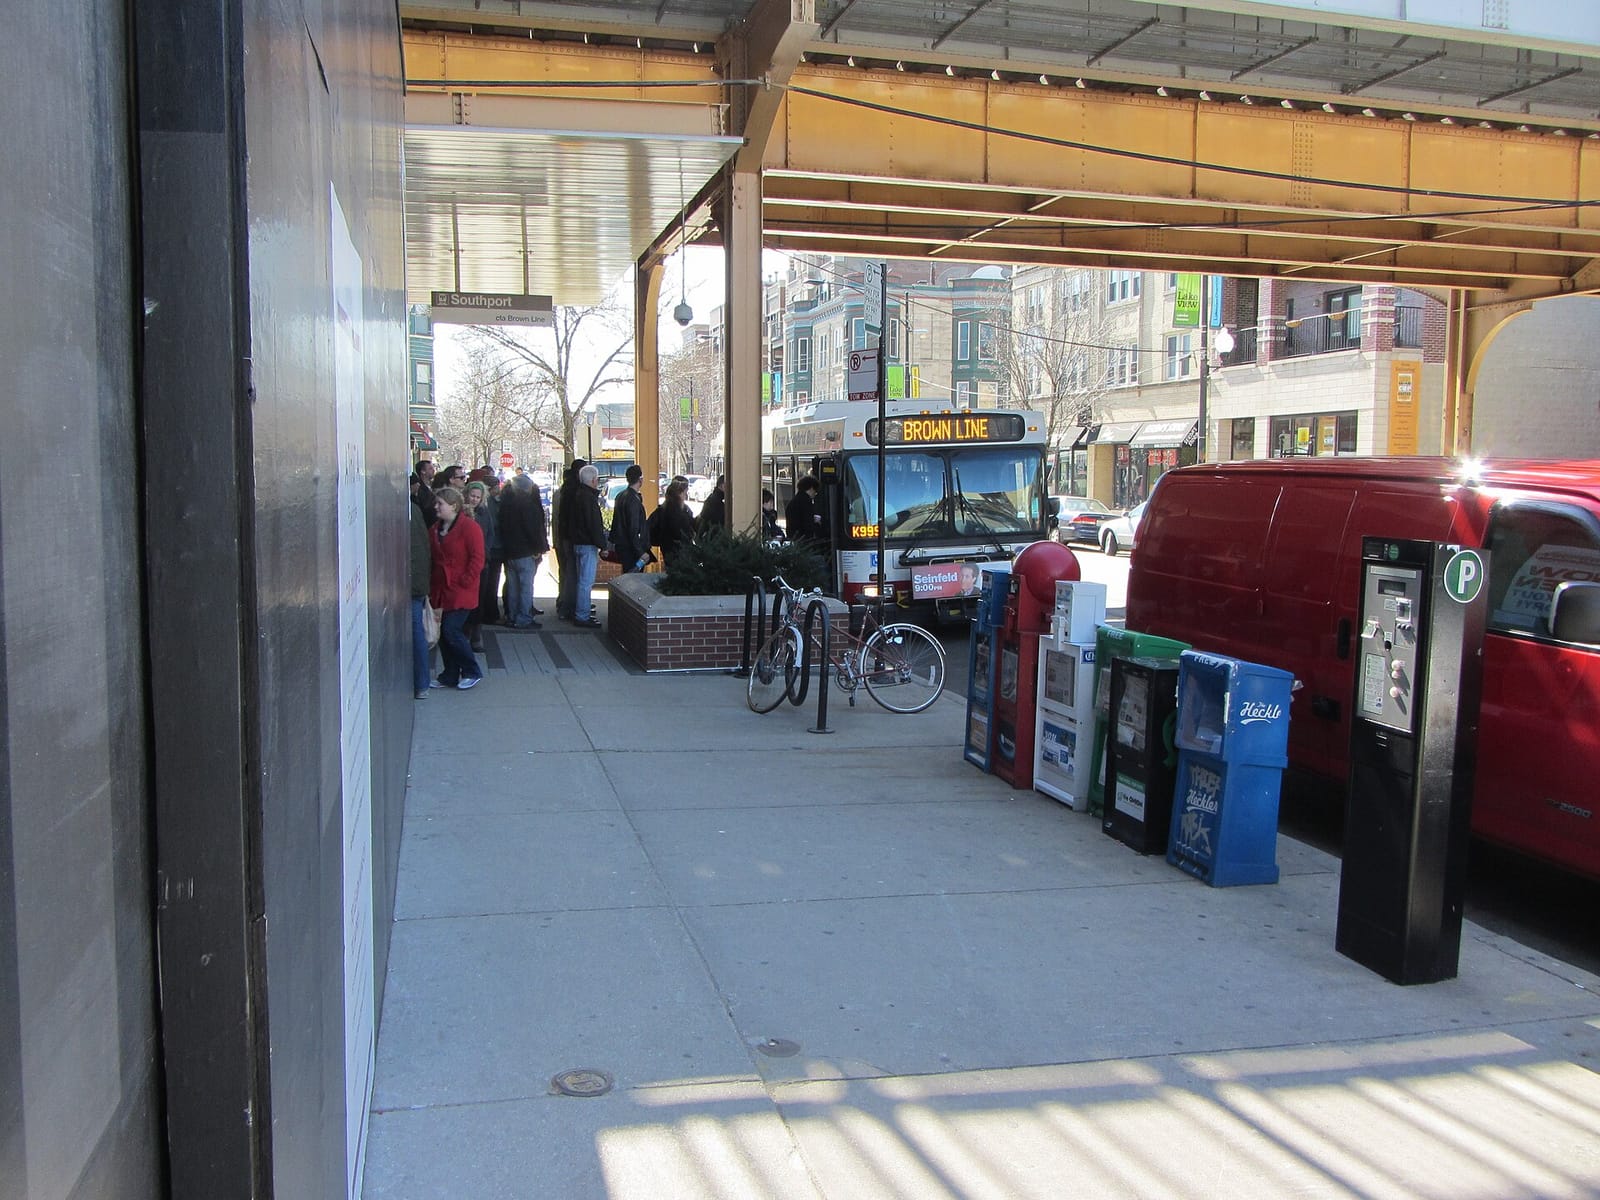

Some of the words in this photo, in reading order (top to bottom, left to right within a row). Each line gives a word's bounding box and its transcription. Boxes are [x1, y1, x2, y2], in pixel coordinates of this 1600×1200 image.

[450, 293, 513, 309] Southport
[508, 315, 530, 323] Brown
[531, 316, 546, 324] Line
[862, 392, 876, 400] ZONE
[903, 419, 951, 441] BROWN
[956, 418, 988, 439] LINE
[500, 456, 515, 465] STOP
[914, 571, 958, 584] Seinfeld
[1457, 560, 1476, 594] P
[1106, 630, 1125, 640] FREE
